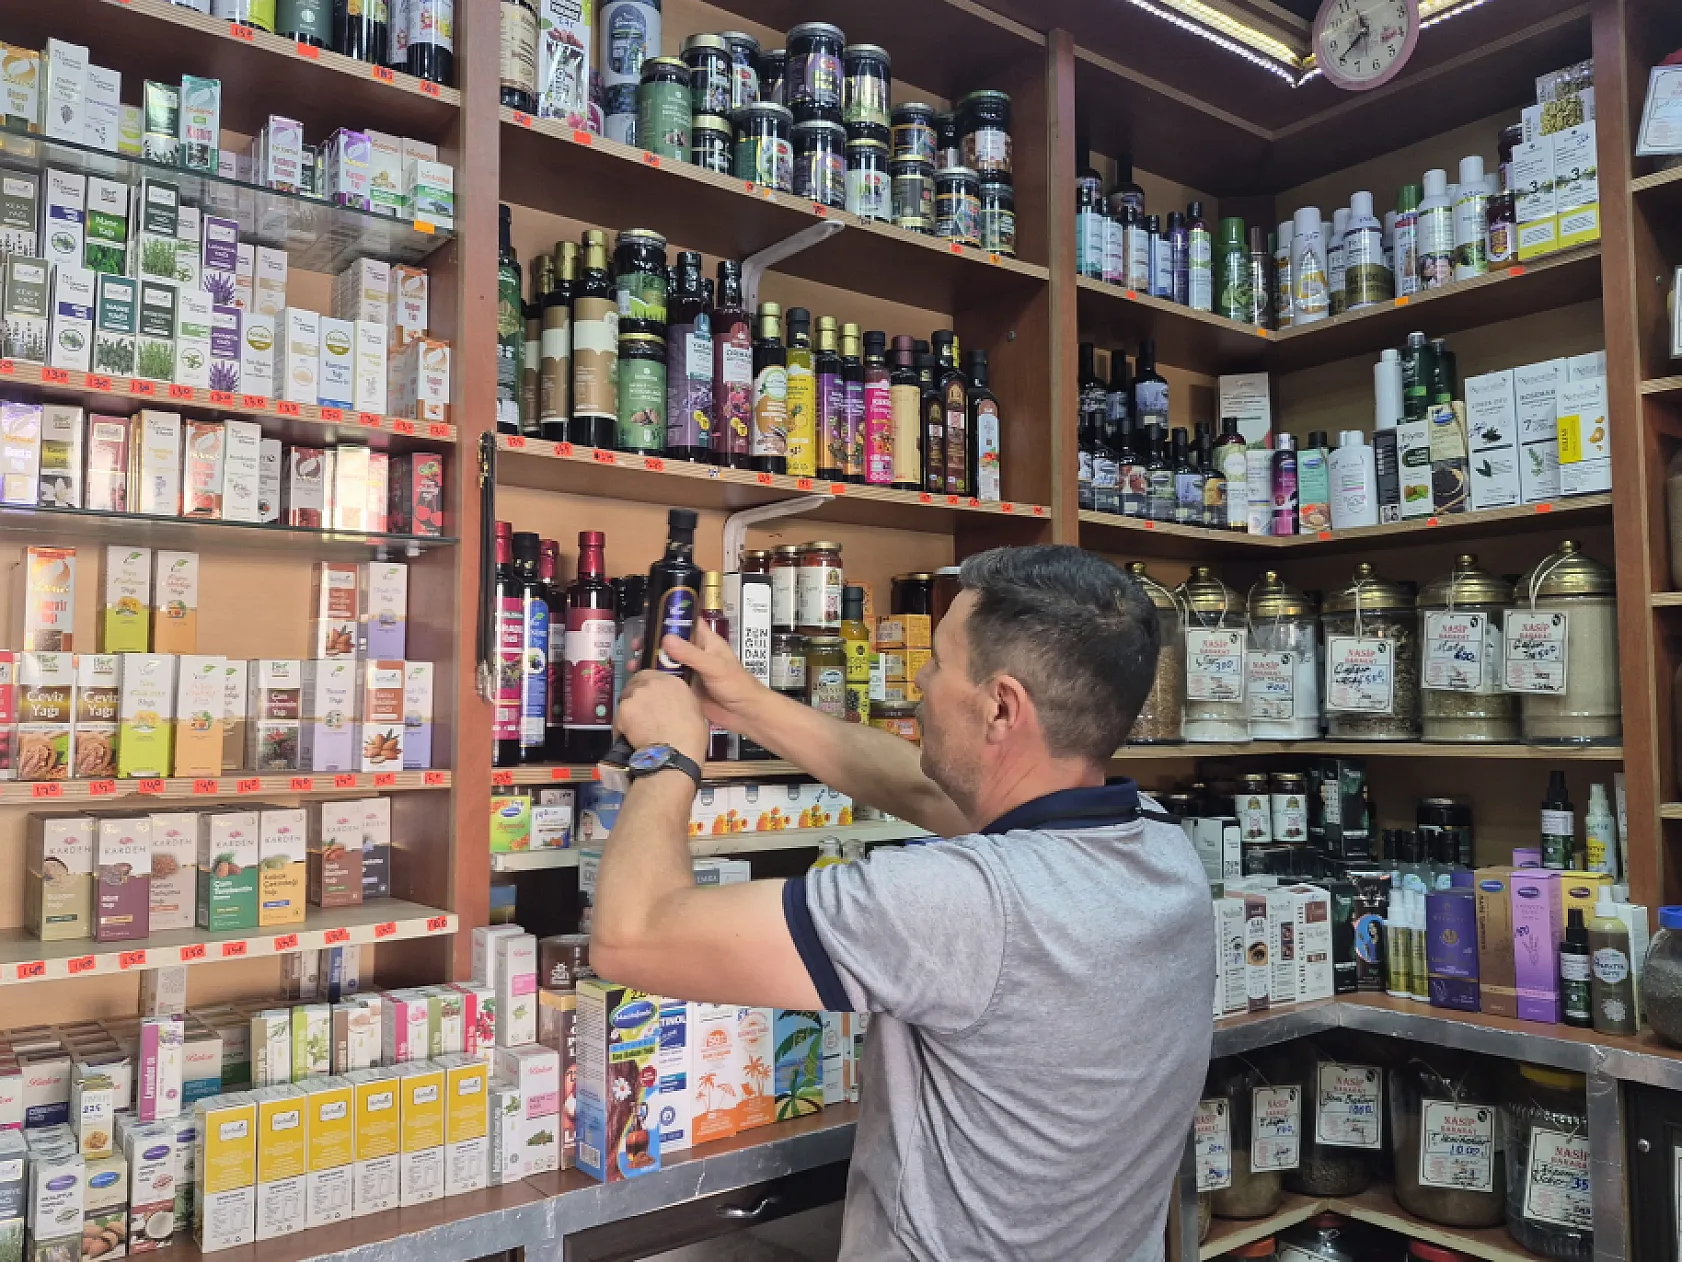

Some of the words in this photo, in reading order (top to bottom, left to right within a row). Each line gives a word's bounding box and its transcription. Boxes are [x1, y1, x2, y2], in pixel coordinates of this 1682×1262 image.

[27, 690, 64, 702] Ceviz
[31, 703, 60, 718] Yağı
[88, 704, 115, 718] Yağı
[326, 824, 360, 834] KARDEN
[152, 838, 193, 847] KARDEN
[216, 839, 255, 849] KARDEN
[264, 833, 303, 844] KARDEN
[49, 845, 92, 855] KARDEN
[104, 845, 147, 856] KARDEN
[1443, 1115, 1477, 1127] NASİP
